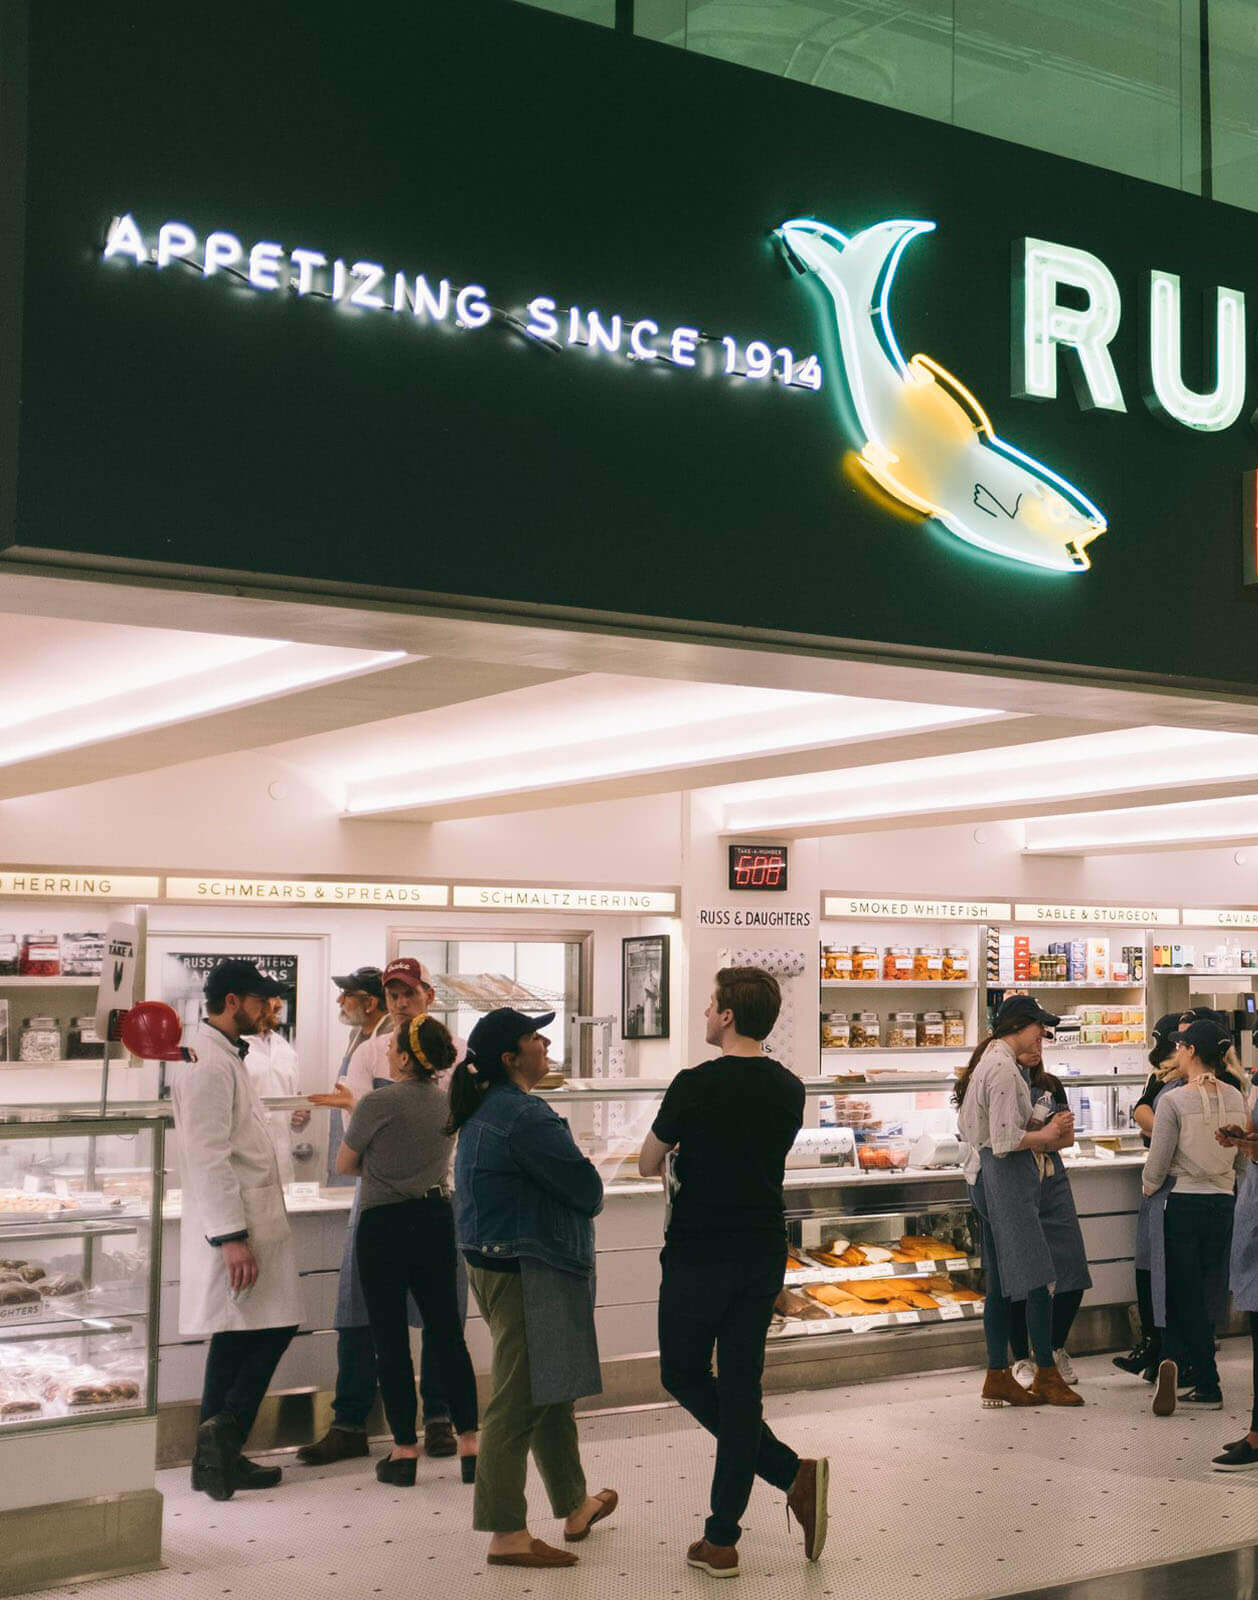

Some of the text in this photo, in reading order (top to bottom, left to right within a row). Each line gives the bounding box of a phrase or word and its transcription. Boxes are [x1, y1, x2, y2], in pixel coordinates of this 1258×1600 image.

[103, 211, 823, 391] APPETIZING SINCE 1914
[12, 877, 112, 893] HERRING
[198, 882, 421, 901] SCHMEARS & SPREADS
[480, 891, 652, 908] SCHMALTZ HERRING
[849, 902, 989, 917] SMOKED WHITEFISH
[1037, 908, 1159, 922] SABLE & STURGEON
[700, 910, 811, 926] RUSS & DAUGHTERS
[1218, 912, 1258, 925] CAVIAR
[183, 957, 214, 969] RUSS
